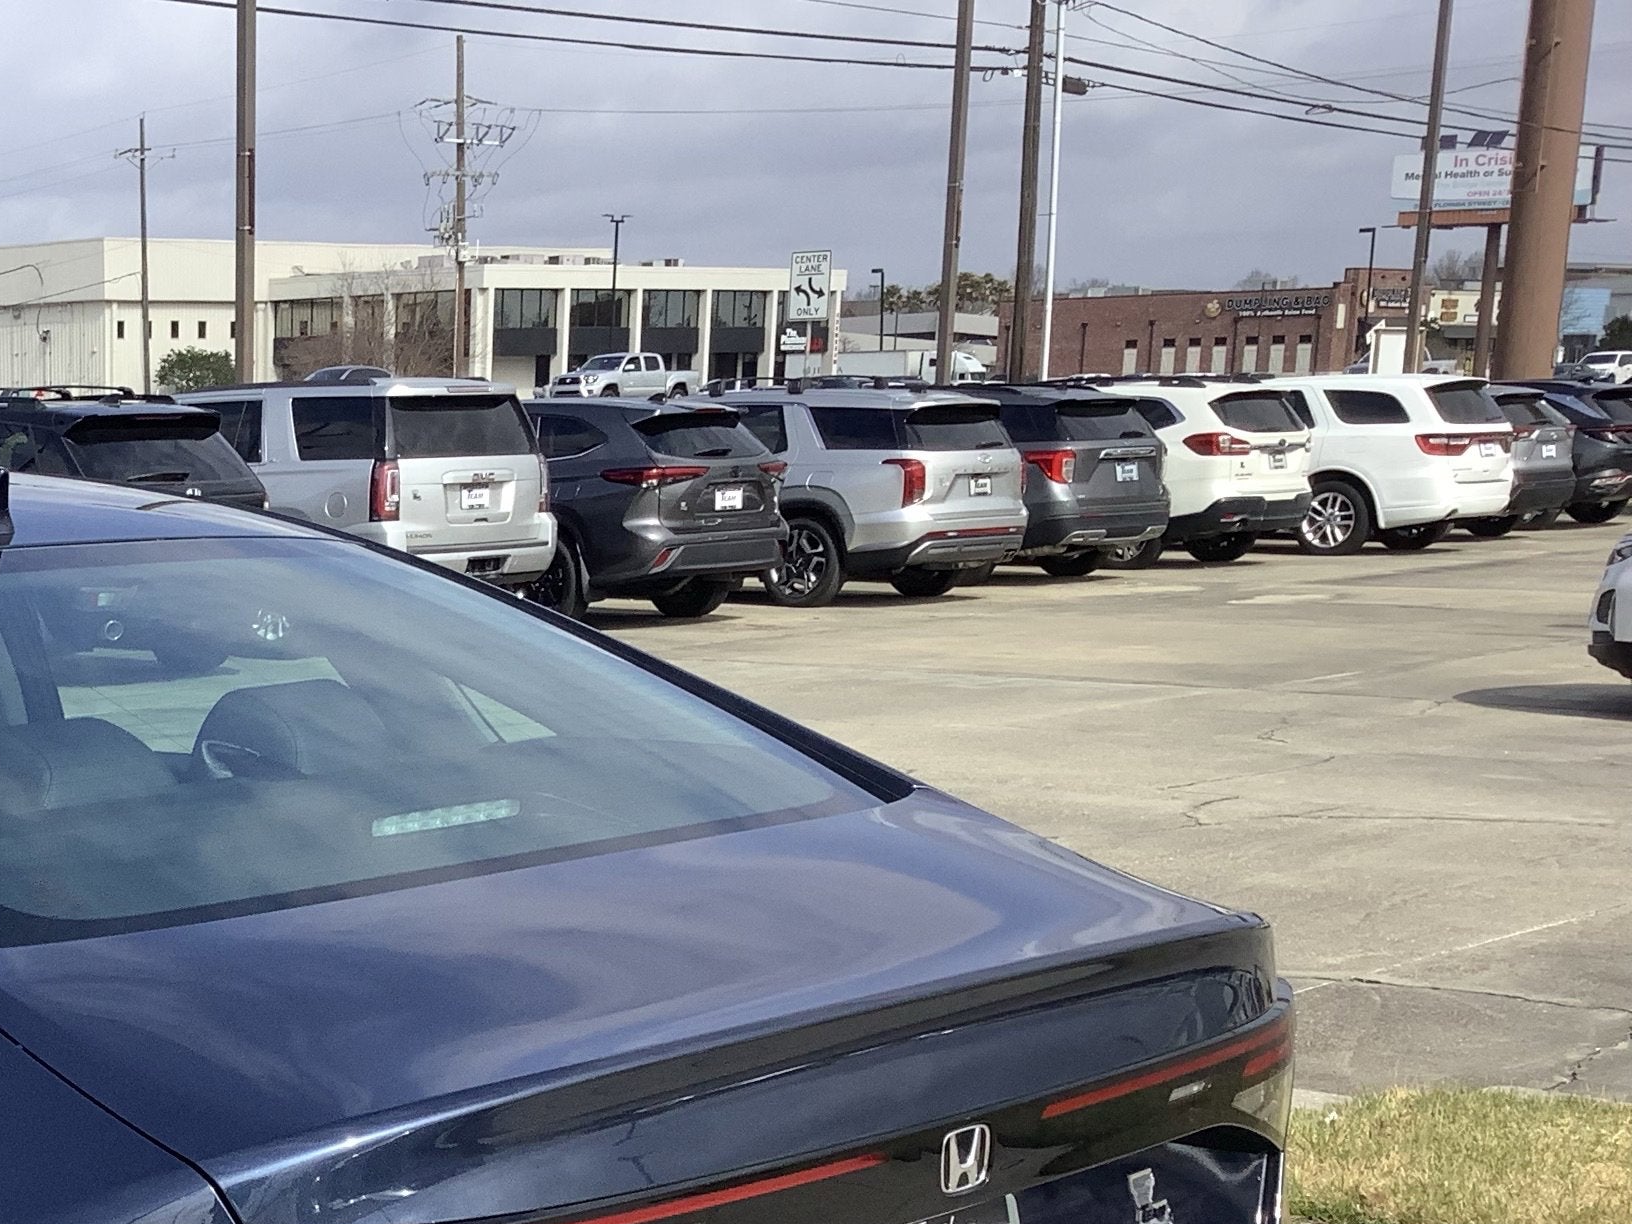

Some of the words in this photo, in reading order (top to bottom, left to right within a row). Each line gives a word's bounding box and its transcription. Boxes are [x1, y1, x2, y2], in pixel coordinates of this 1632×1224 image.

[1454, 154, 1469, 168] In
[1475, 151, 1513, 167] Crisi
[1404, 171, 1442, 181] Meal
[1444, 169, 1480, 179] Health
[1497, 167, 1512, 177] Su
[794, 254, 828, 264] CENTER
[799, 263, 823, 274] LANE
[796, 307, 820, 316] ONLY
